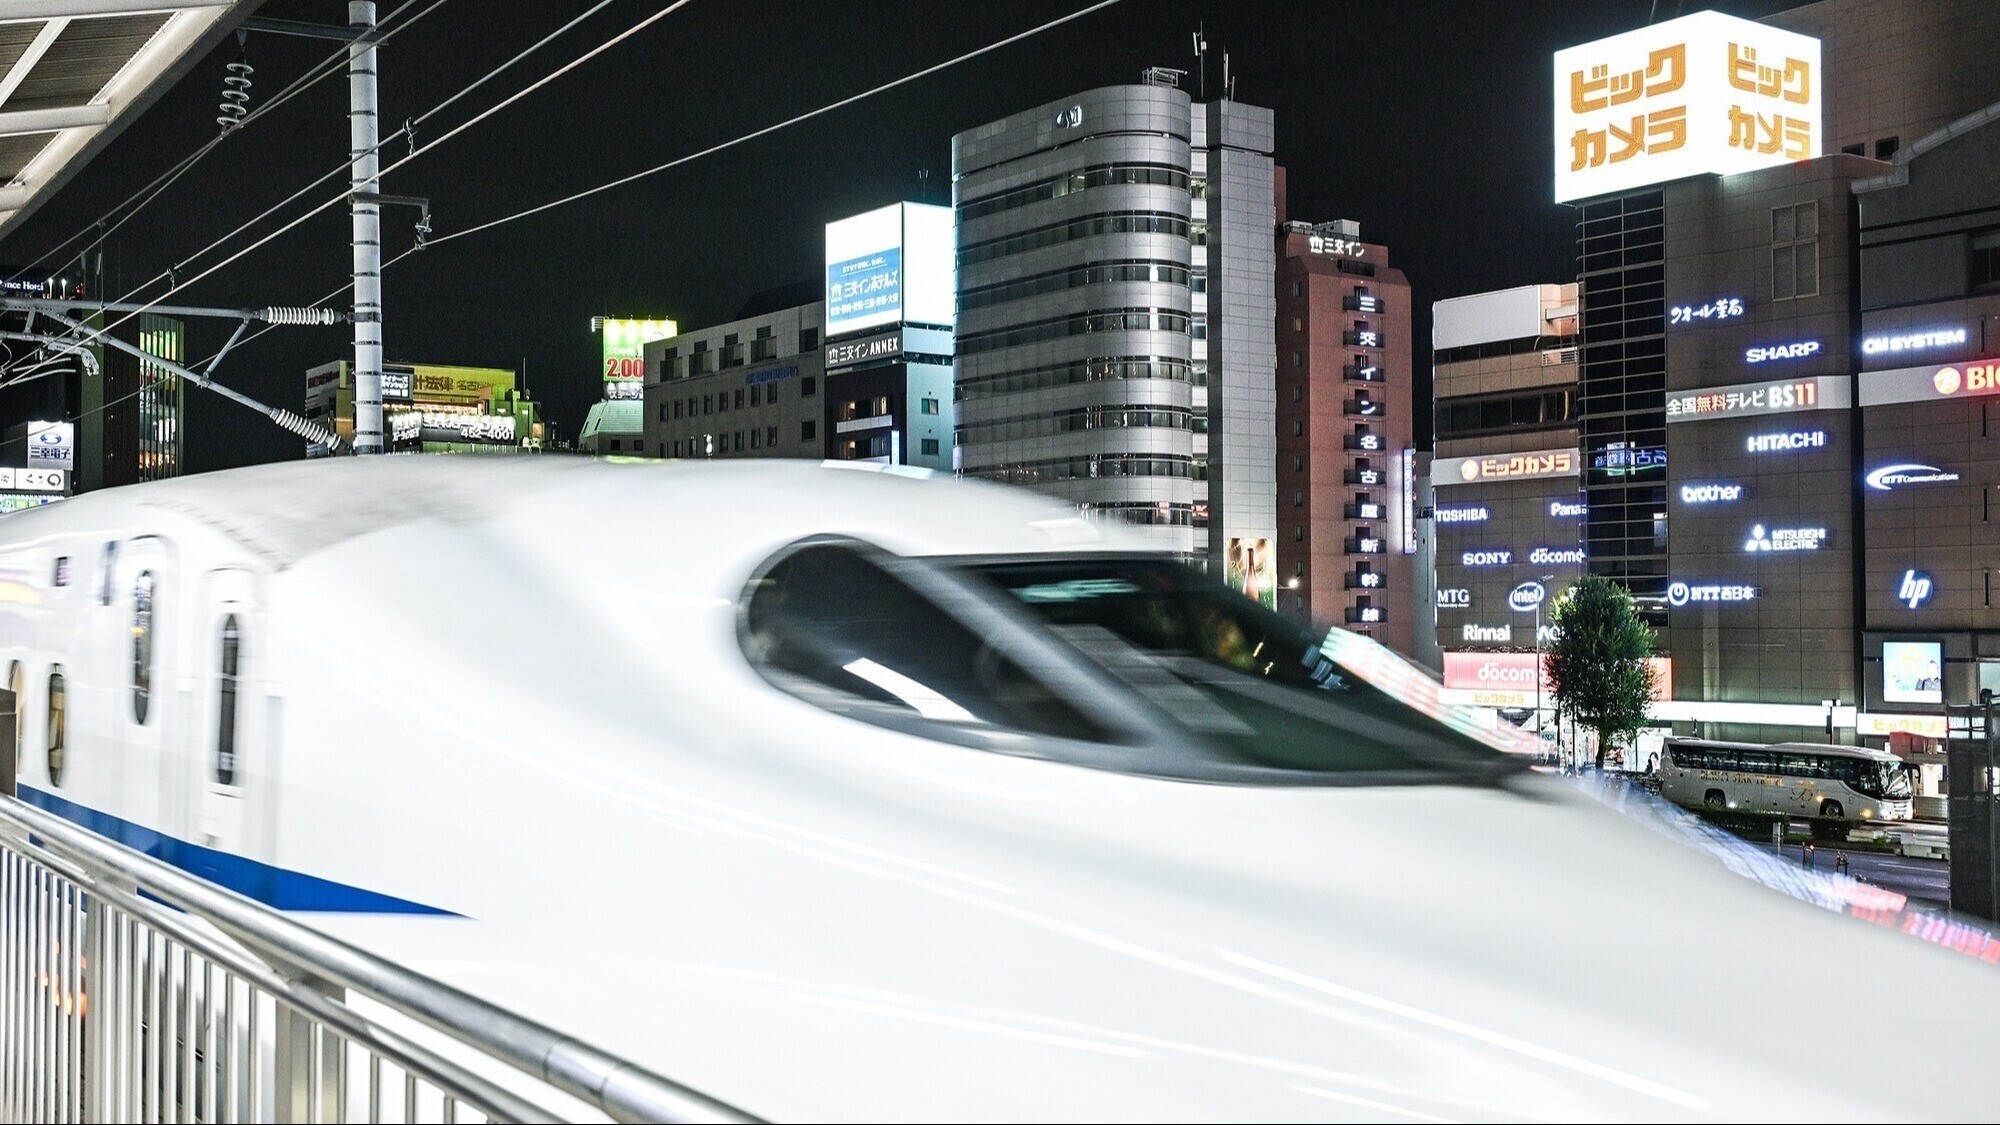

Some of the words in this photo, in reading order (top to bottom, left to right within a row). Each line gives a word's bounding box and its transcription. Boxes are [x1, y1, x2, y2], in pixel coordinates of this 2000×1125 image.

[1571, 43, 1686, 114] ビック
[1728, 42, 1810, 105] ビック
[1571, 105, 1687, 172] カメラ
[1728, 105, 1810, 160] カメラ
[1324, 237, 1364, 257] 三交イン
[1671, 298, 1744, 324] クオール薬局
[840, 344, 868, 361] 三交イン
[870, 337, 898, 355] ANNEX
[1863, 338, 1888, 353] OM
[1890, 329, 1966, 350] SYSTEM
[1746, 341, 1820, 363] SHARP
[1667, 389, 1766, 415] 全国無料テレビ
[1769, 383, 1815, 409] BS11
[1747, 431, 1824, 451] HITACHI
[1481, 453, 1571, 477] ビックカメラ
[1904, 473, 1960, 483] Communications
[1682, 485, 1741, 502] brother
[1436, 508, 1488, 523] TOSHIBA
[1772, 528, 1825, 540] MITSUBISHI
[1772, 539, 1818, 550] ELECTRIC
[1463, 552, 1511, 565] SONY
[1437, 589, 1470, 603] MTG
[1514, 588, 1538, 603] intel
[1690, 585, 1754, 600] NTT西日本
[1899, 569, 1931, 609] hp
[1463, 624, 1511, 641] Rinnai
